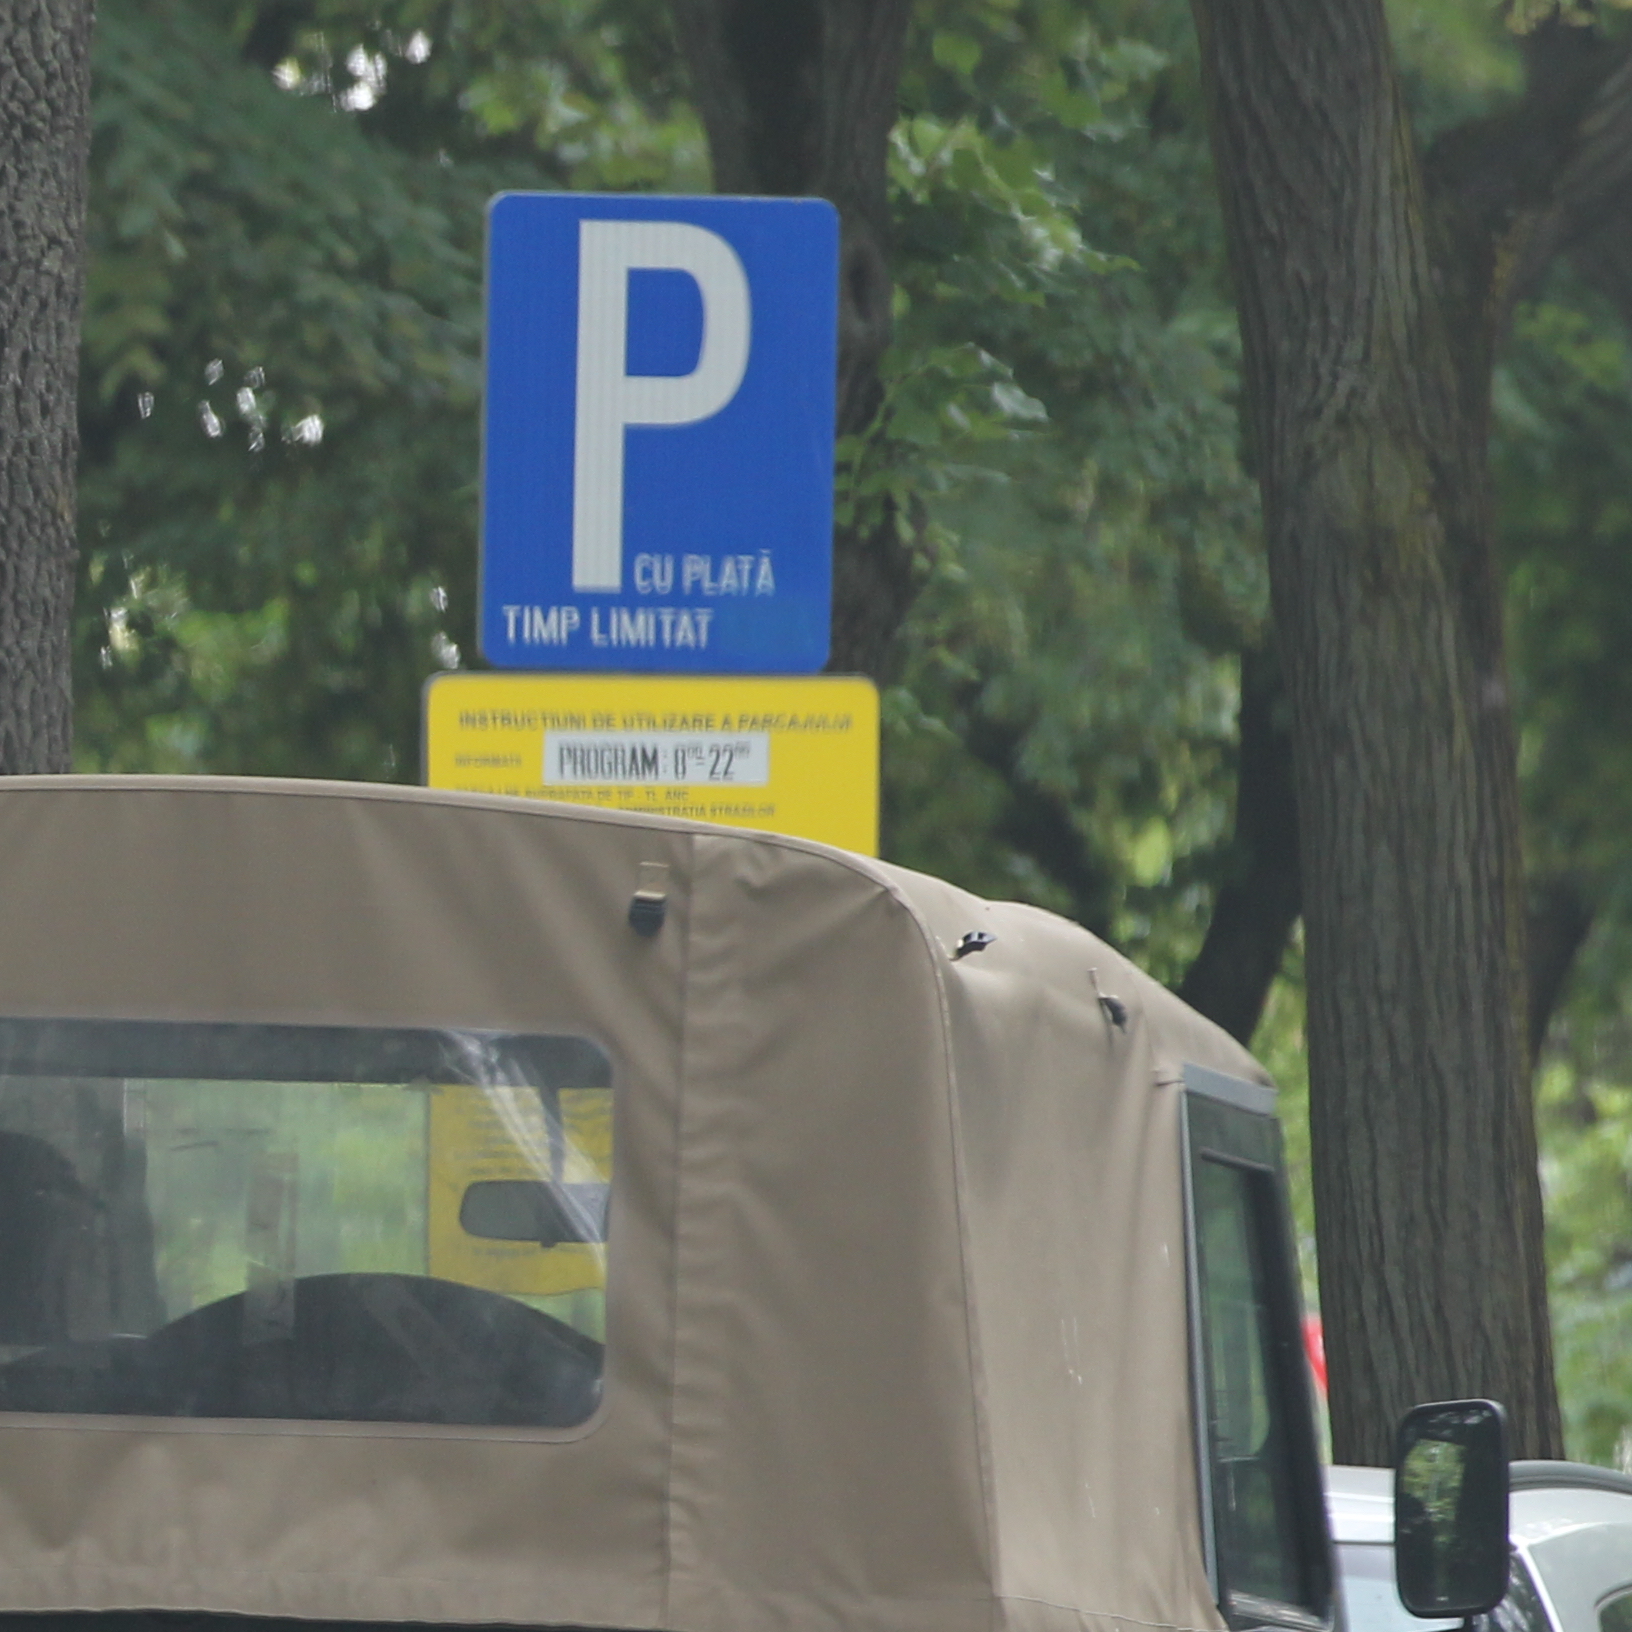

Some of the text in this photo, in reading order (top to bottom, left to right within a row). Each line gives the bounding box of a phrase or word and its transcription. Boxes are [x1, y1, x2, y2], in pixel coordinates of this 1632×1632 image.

[572, 218, 751, 594] P
[634, 548, 776, 596] CU PLATĂ
[502, 604, 714, 648] TIMP LIMITAT
